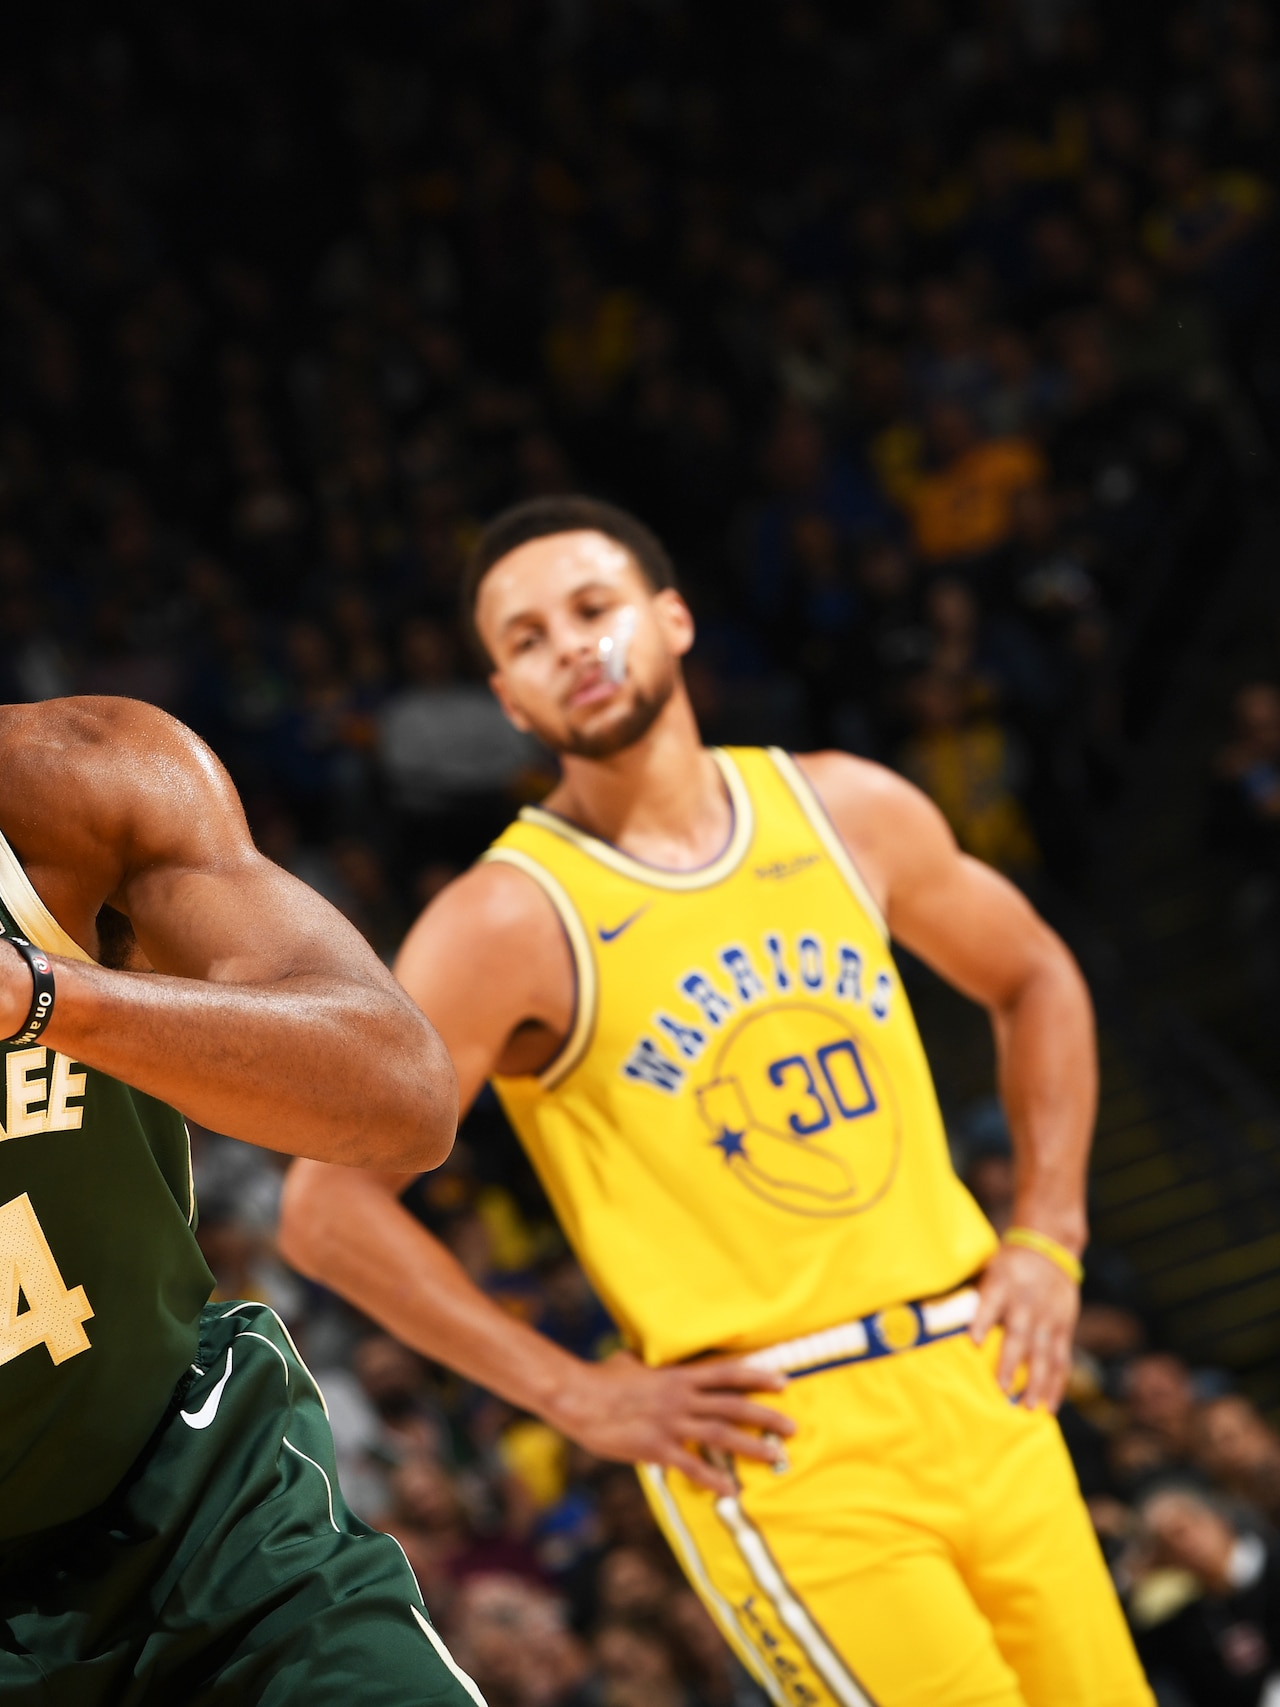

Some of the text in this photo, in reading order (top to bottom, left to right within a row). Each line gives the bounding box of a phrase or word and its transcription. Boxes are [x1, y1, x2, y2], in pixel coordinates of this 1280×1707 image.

[29, 1021, 42, 1030] a
[35, 991, 52, 1018] On
[619, 934, 892, 1096] WARRIORS
[767, 1039, 878, 1136] 30
